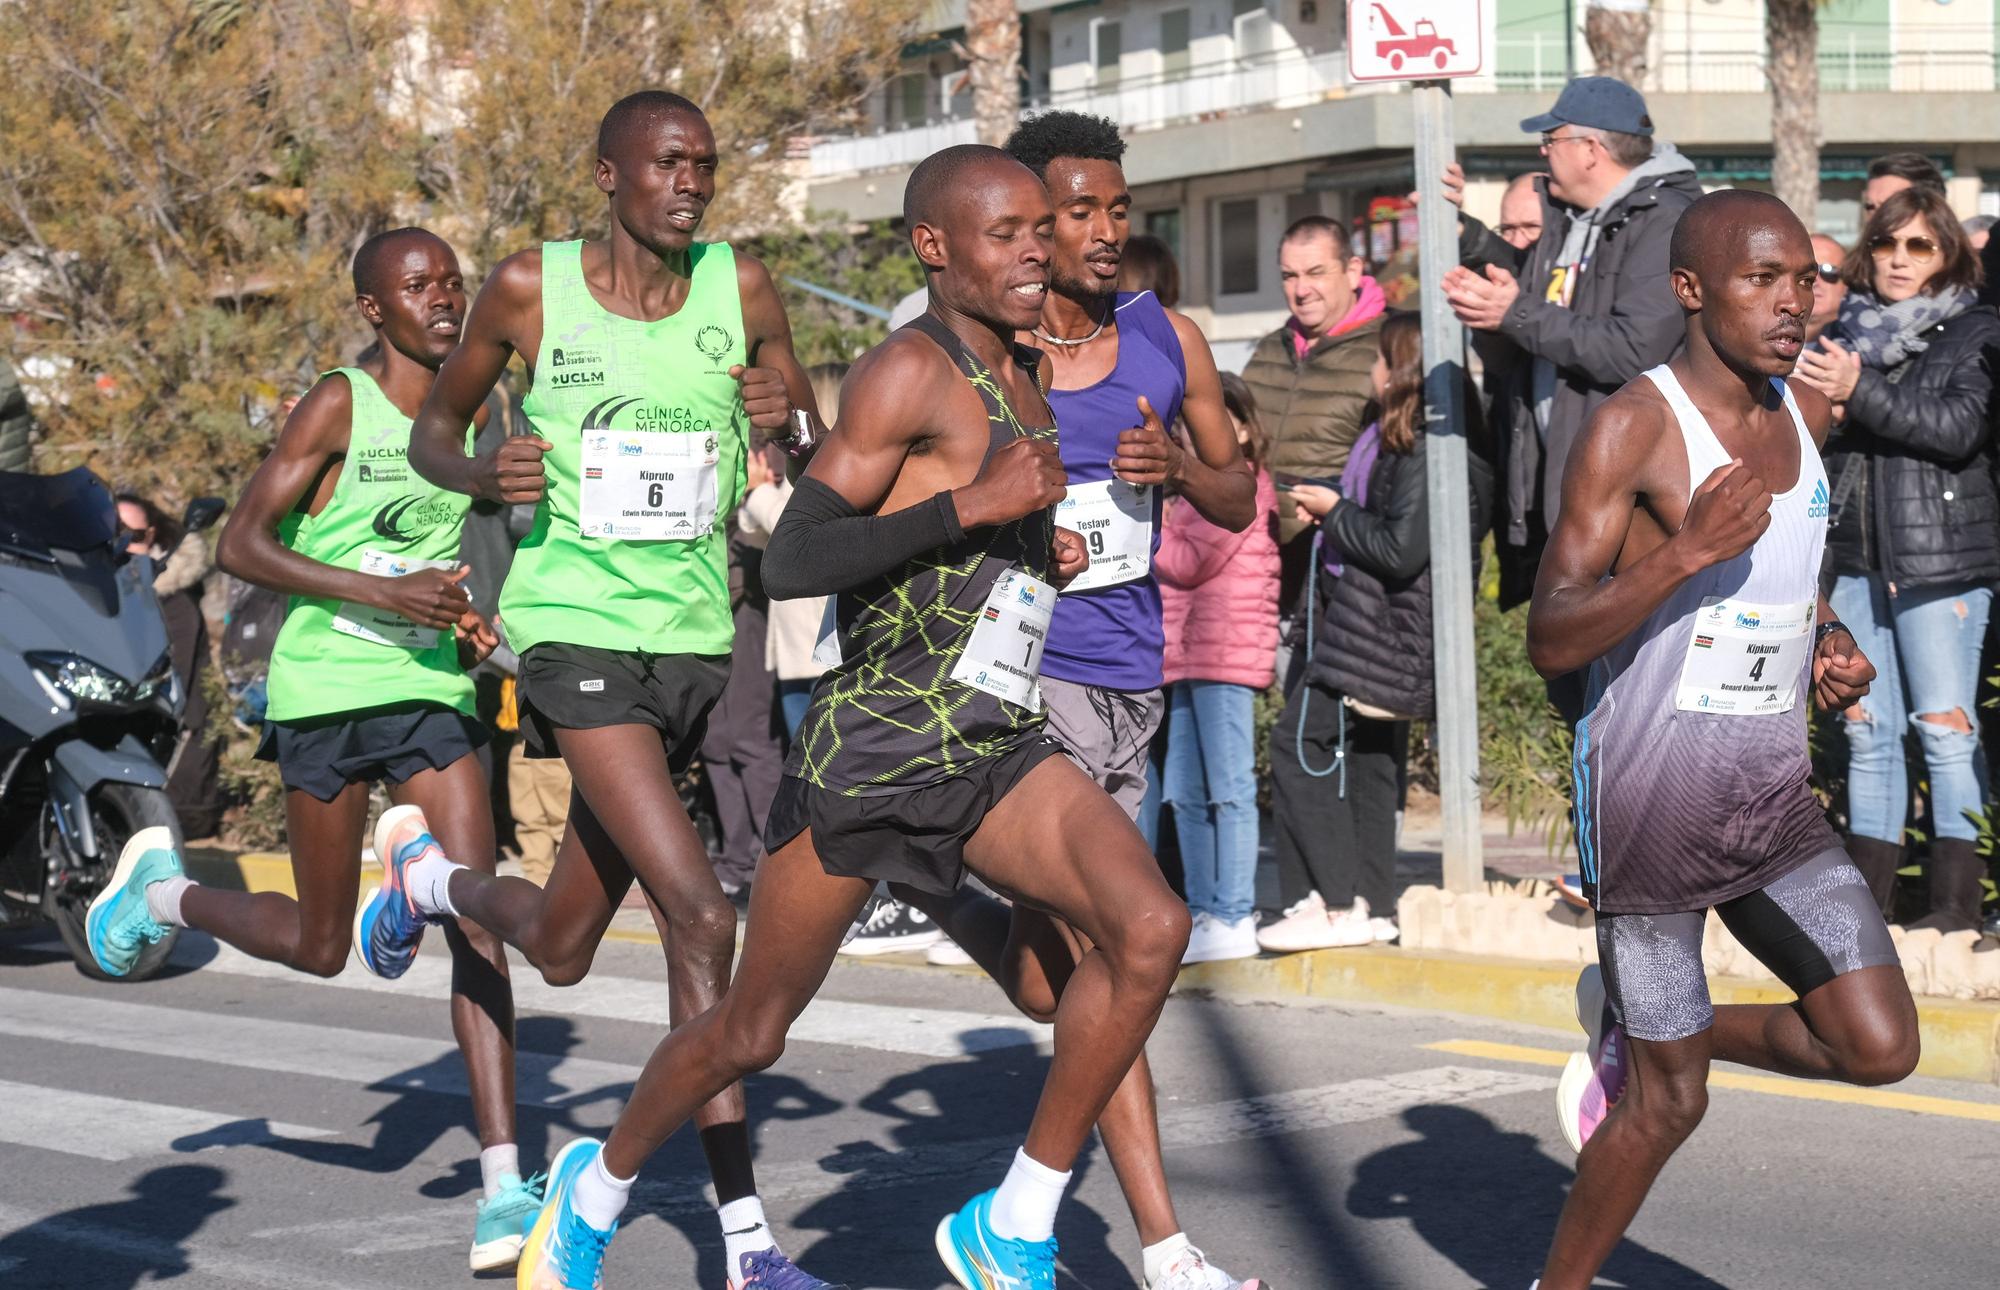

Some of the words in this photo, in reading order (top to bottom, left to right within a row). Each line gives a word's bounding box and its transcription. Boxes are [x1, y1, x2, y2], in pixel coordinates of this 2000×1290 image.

[560, 371, 604, 384] UCLM
[635, 406, 692, 419] CLÍNICA
[635, 420, 712, 433] MENORCA
[368, 448, 406, 458] UCLM
[639, 470, 674, 482] Kipruto
[647, 483, 664, 508] 6
[416, 513, 459, 527] MENORC
[1077, 518, 1111, 530] Tesfaye
[1089, 530, 1105, 555] 9
[1023, 640, 1034, 668] 1
[1746, 644, 1781, 655] Kipkurui
[993, 660, 1009, 672] Alfred
[1749, 656, 1766, 682] 4
[1720, 683, 1742, 692] Benard
